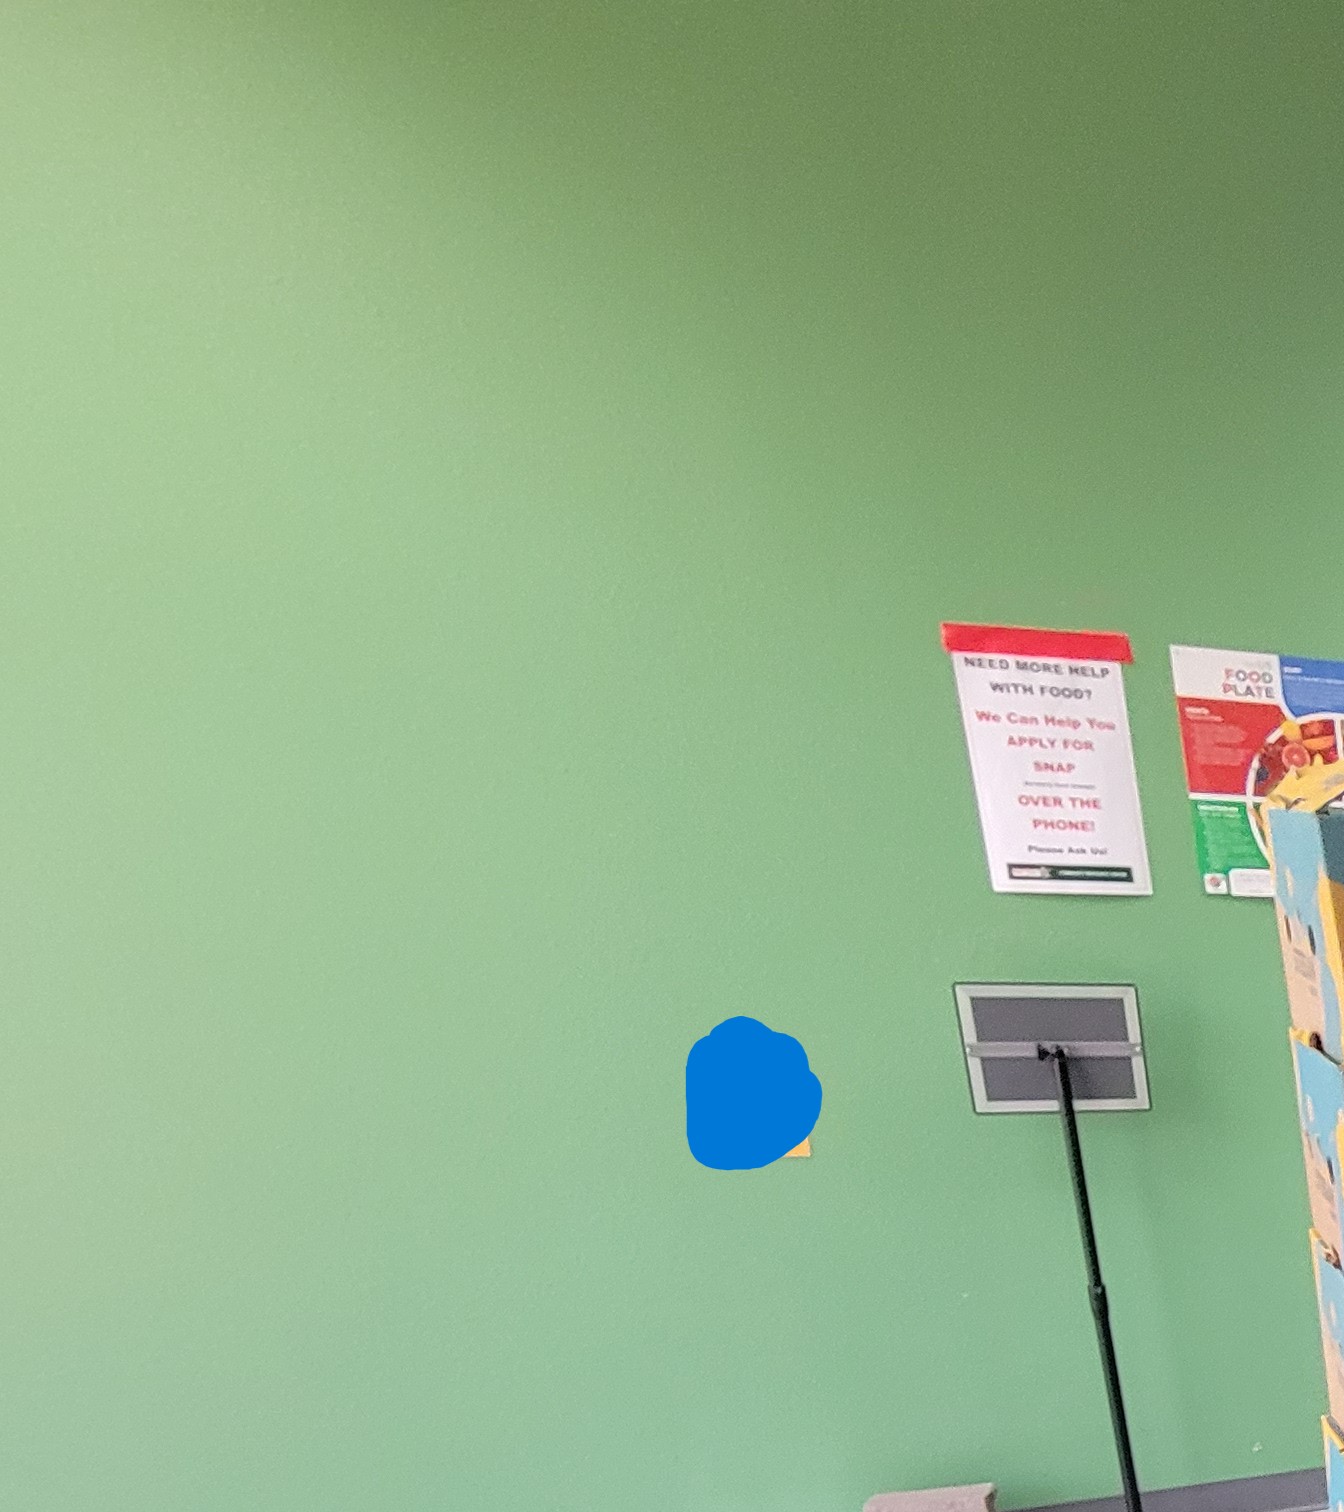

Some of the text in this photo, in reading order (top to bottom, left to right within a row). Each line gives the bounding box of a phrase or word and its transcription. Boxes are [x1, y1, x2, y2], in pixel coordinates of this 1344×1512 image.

[964, 656, 1110, 679] NEED MORE HELP
[1224, 668, 1273, 684] FOOD
[990, 681, 1092, 700] WITH FOOD?
[1221, 683, 1276, 698] PLATE
[975, 709, 1116, 731] We Can Help You
[1007, 735, 1095, 751] APPLY FOR
[1033, 761, 1075, 774] SNAP
[1017, 794, 1102, 810] OVER THE
[1032, 818, 1095, 832] PHONE!
